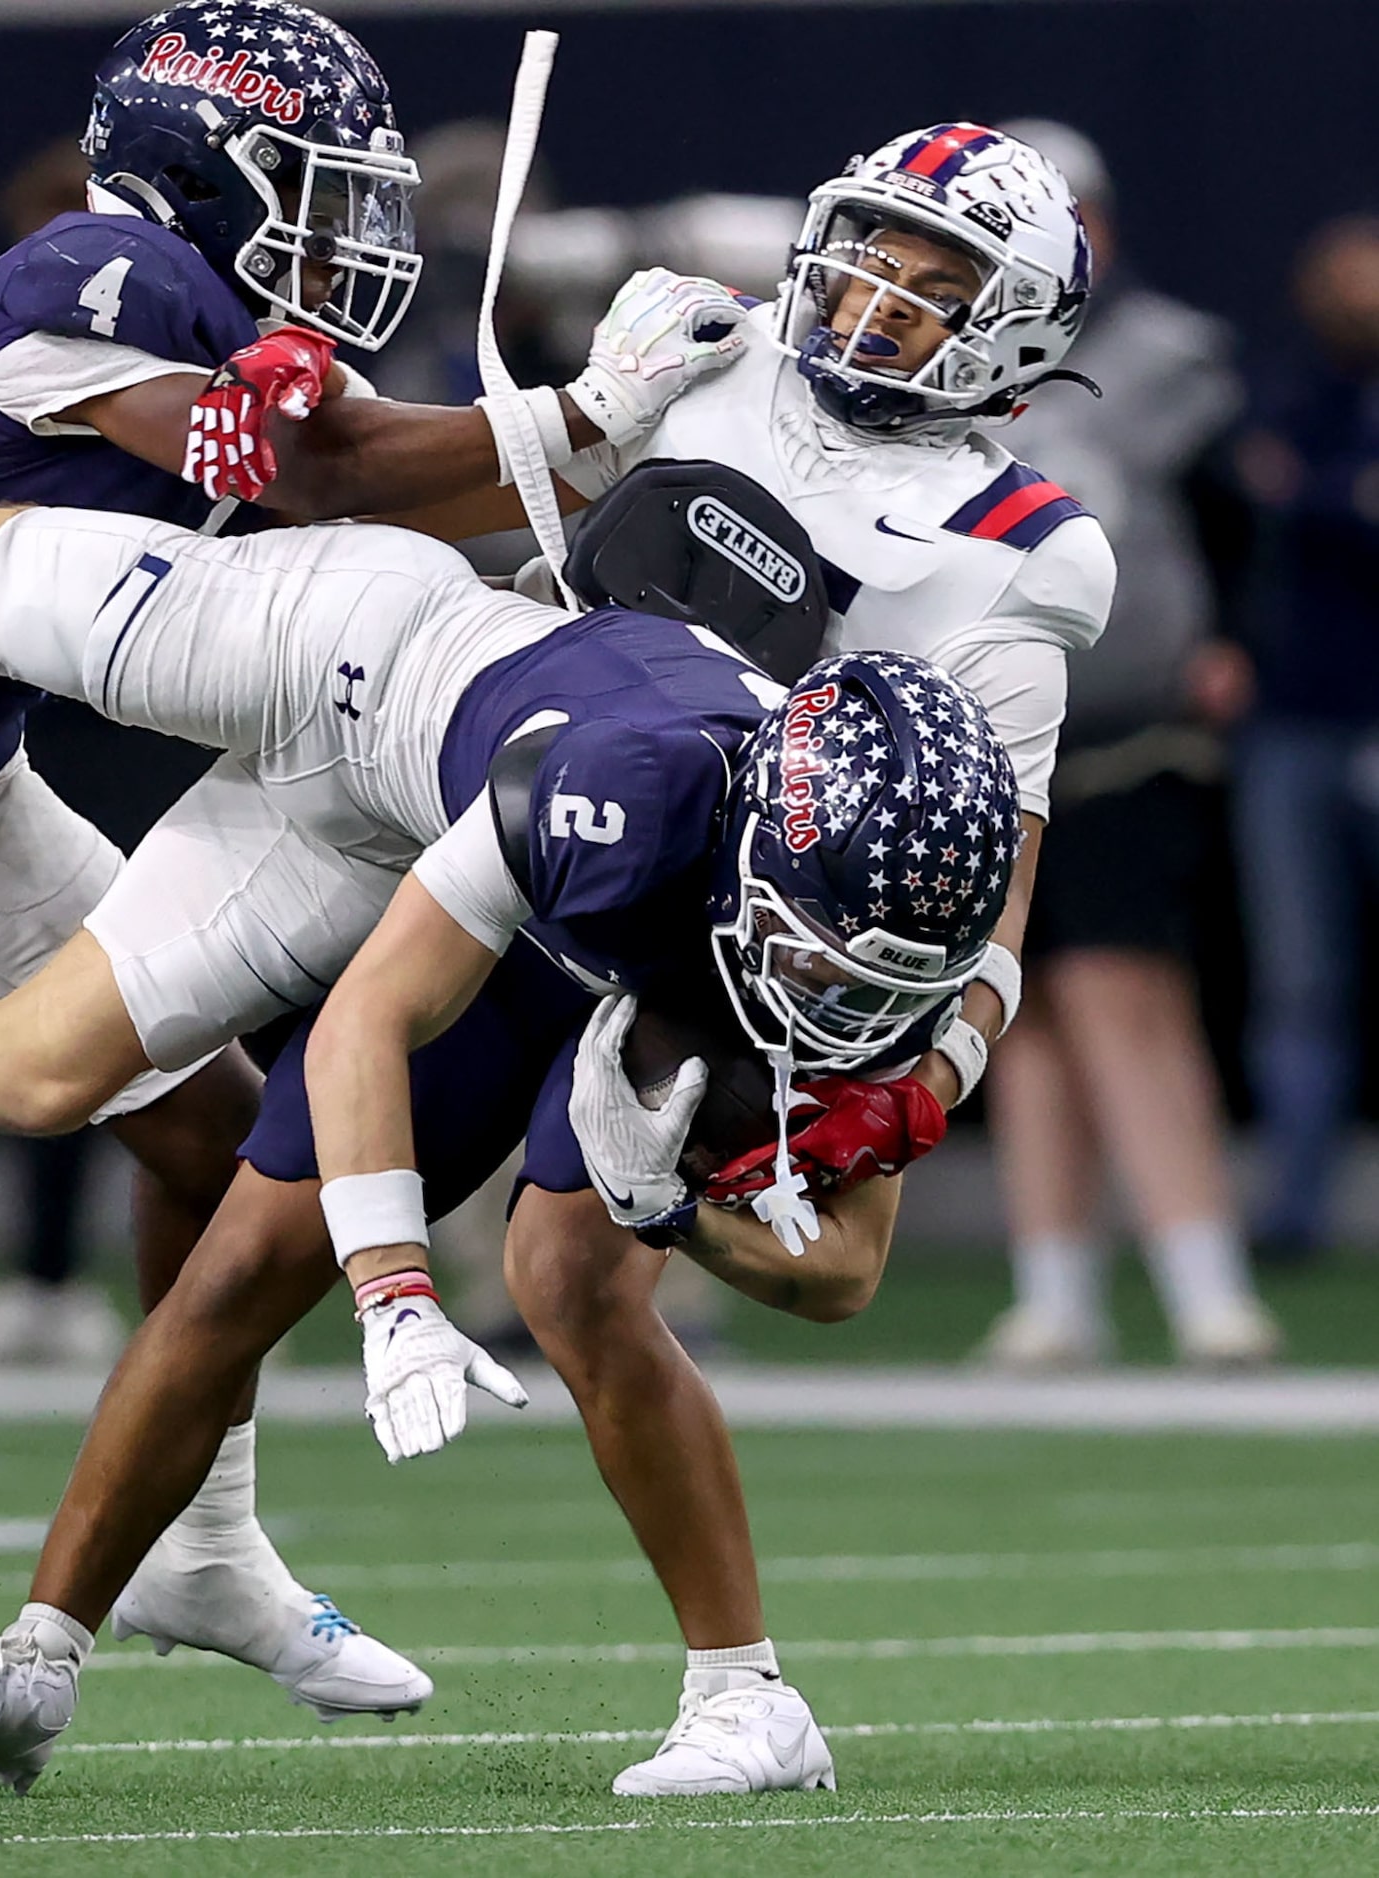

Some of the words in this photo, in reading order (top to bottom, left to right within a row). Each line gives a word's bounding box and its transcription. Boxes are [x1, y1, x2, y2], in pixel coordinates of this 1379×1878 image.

[137, 32, 305, 124] Raiders
[78, 256, 134, 337] 4
[697, 504, 799, 594] BATTLE
[780, 682, 838, 853] Raiders
[550, 793, 626, 845] 2
[877, 946, 932, 973] BLUE
